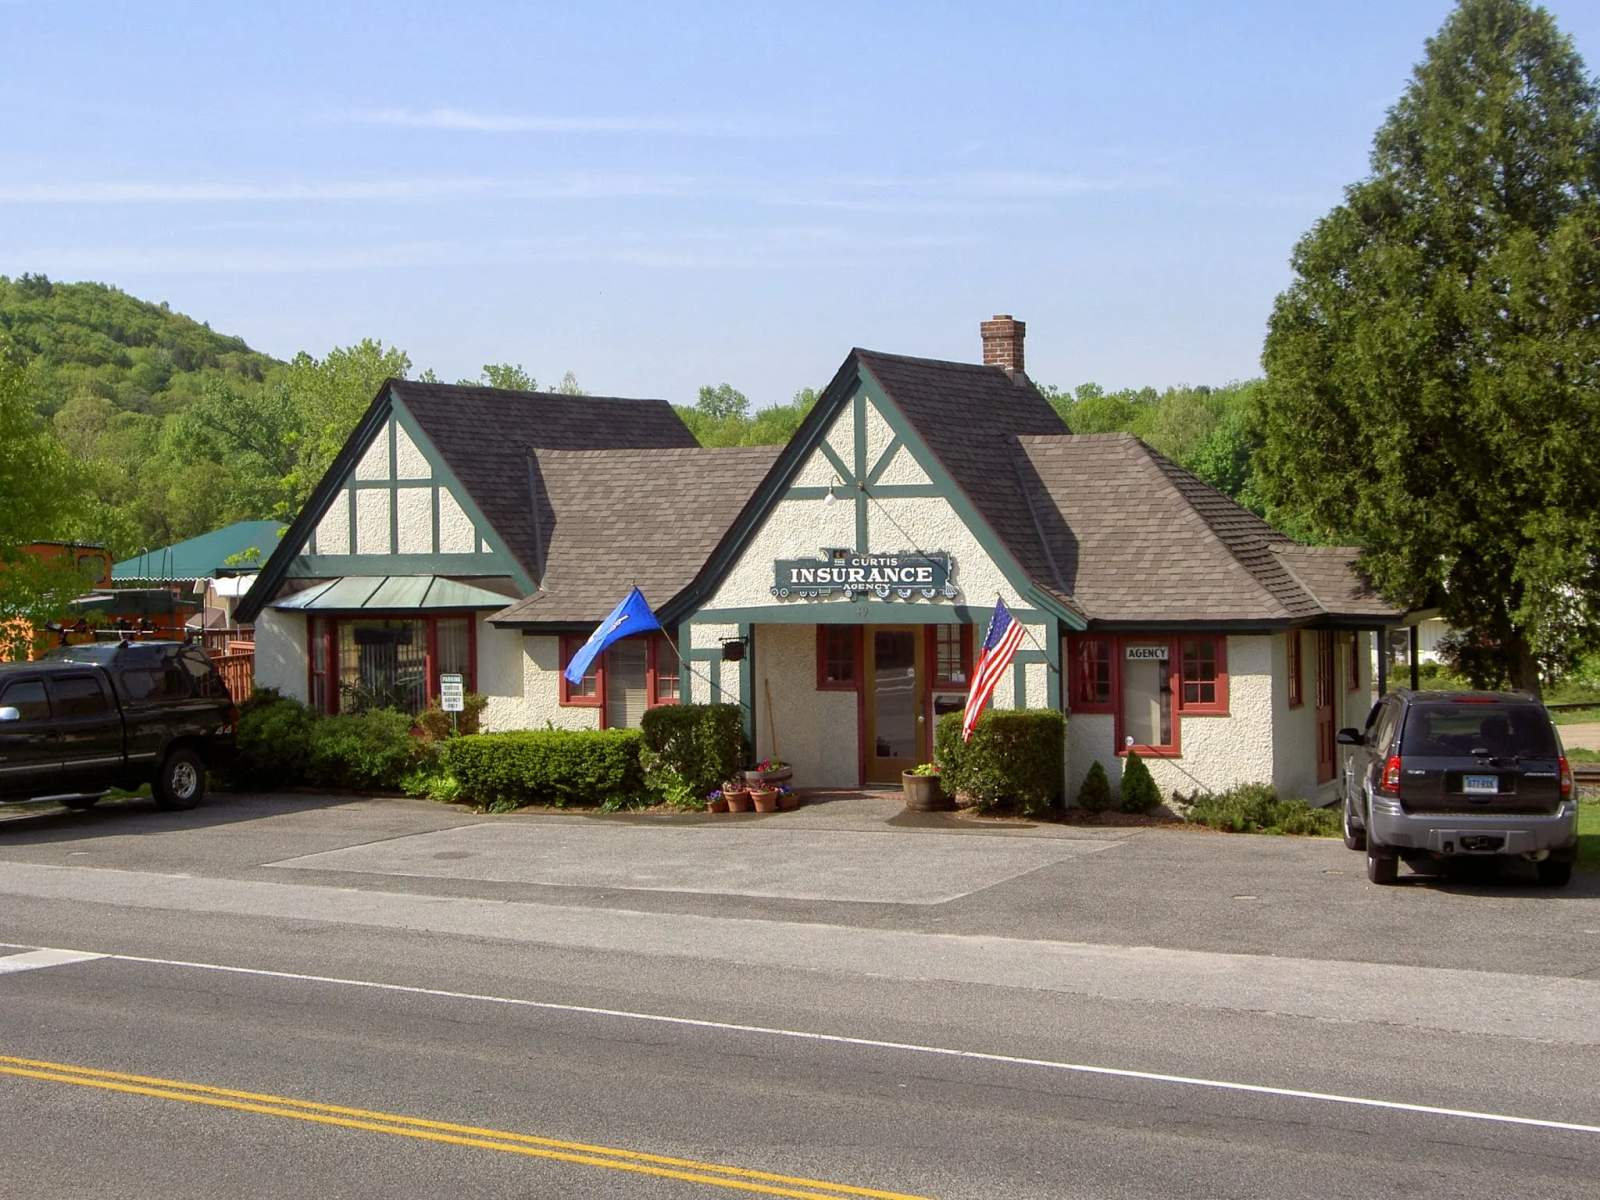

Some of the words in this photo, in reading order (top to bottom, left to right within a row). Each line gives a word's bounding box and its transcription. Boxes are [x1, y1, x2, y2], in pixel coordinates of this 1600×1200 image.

[852, 557, 898, 567] CURTIS
[790, 567, 933, 583] INSURANCE
[842, 582, 891, 591] AGENCY
[1128, 648, 1166, 658] AGENCY
